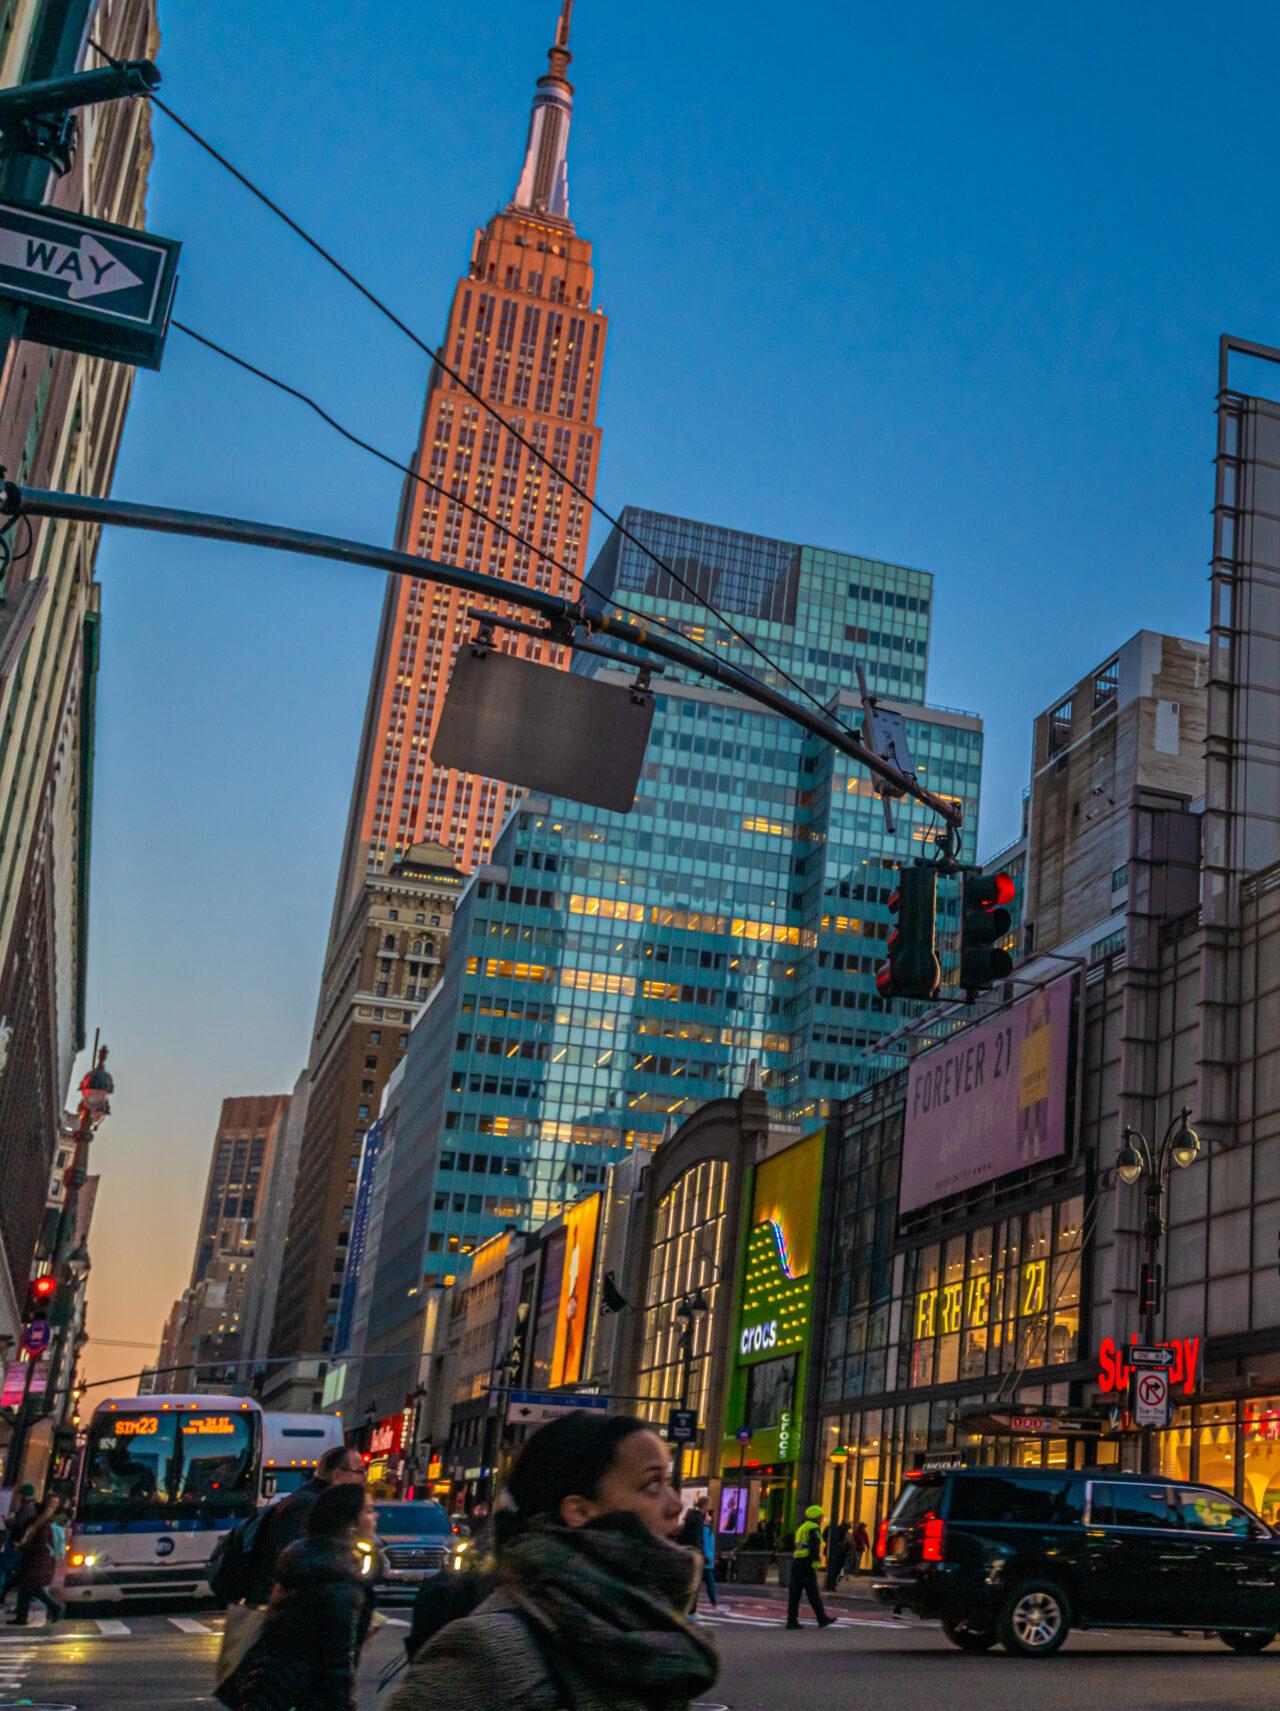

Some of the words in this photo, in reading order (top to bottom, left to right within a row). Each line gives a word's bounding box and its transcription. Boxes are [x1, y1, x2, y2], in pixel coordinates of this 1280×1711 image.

[26, 239, 116, 285] WAY
[913, 1041, 986, 1118] FOREVER
[993, 1027, 1012, 1079] 21
[1024, 1260, 1046, 1316] 21
[512, 1335, 522, 1378] KAY
[740, 1320, 777, 1354] crocs
[1098, 1333, 1199, 1395] Suay
[115, 1417, 158, 1434] SIM23
[779, 1413, 791, 1459] crocs
